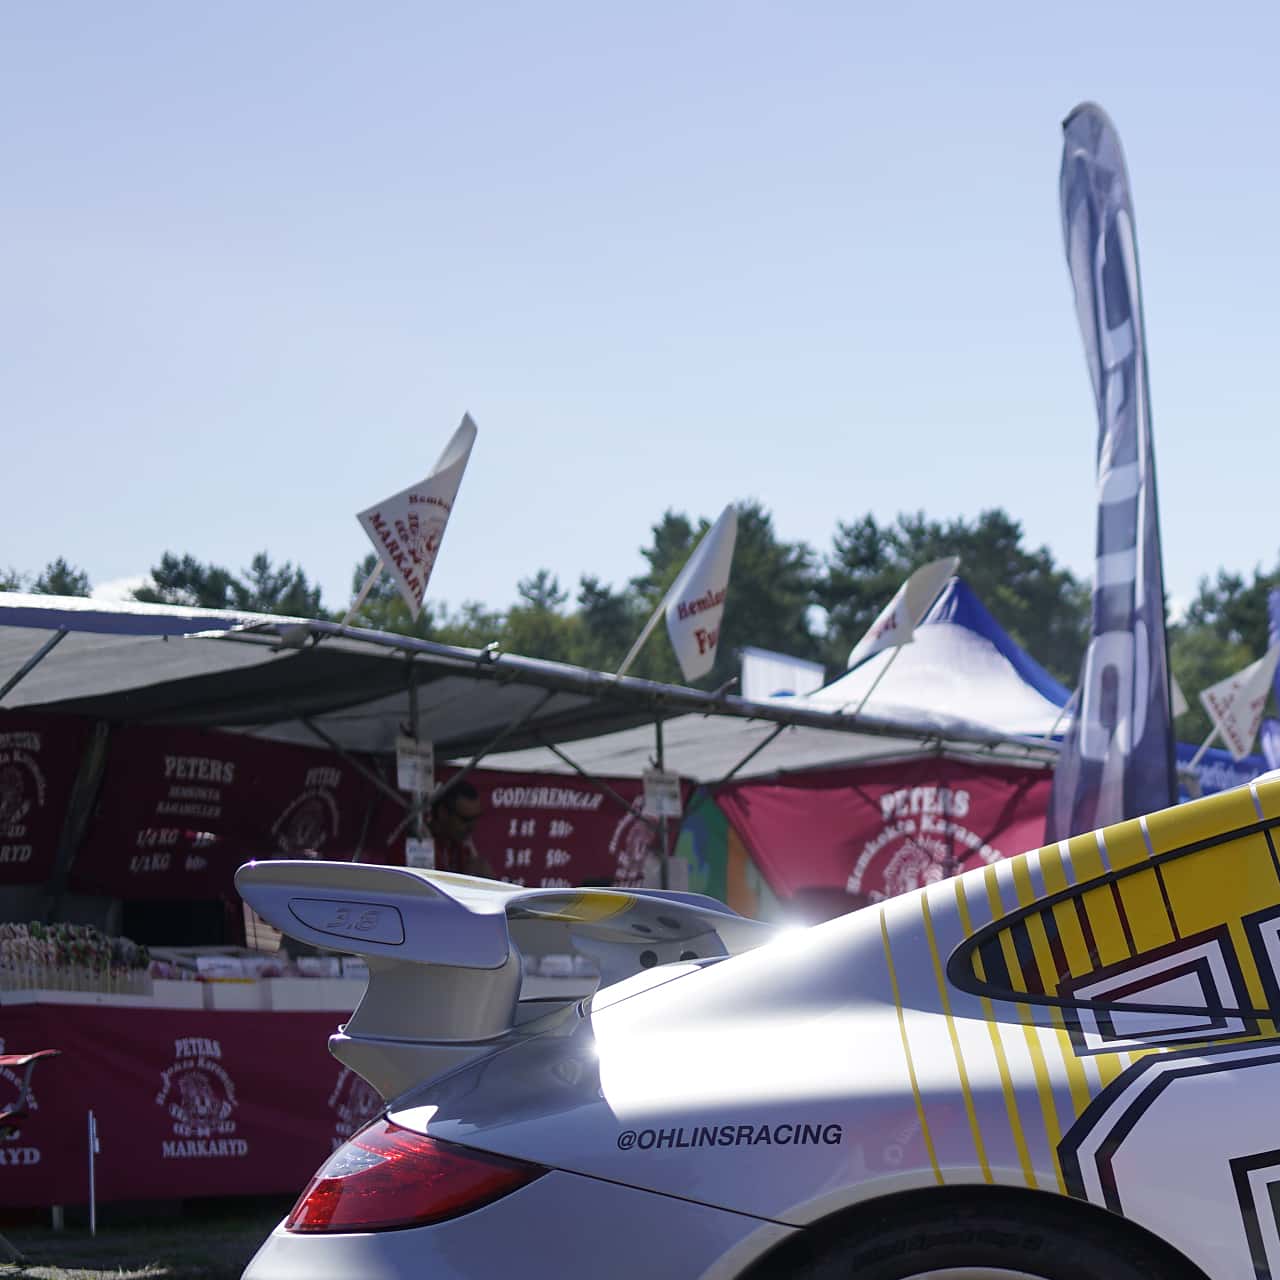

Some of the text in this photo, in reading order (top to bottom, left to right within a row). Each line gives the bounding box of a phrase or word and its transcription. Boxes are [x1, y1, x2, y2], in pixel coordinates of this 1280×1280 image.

[164, 756, 235, 784] PETERS
[879, 786, 970, 821] PETERS
[175, 1038, 221, 1058] PETERS
[163, 1139, 248, 1157] MARKARYD
[616, 1124, 843, 1150] @OHLINSRACING
